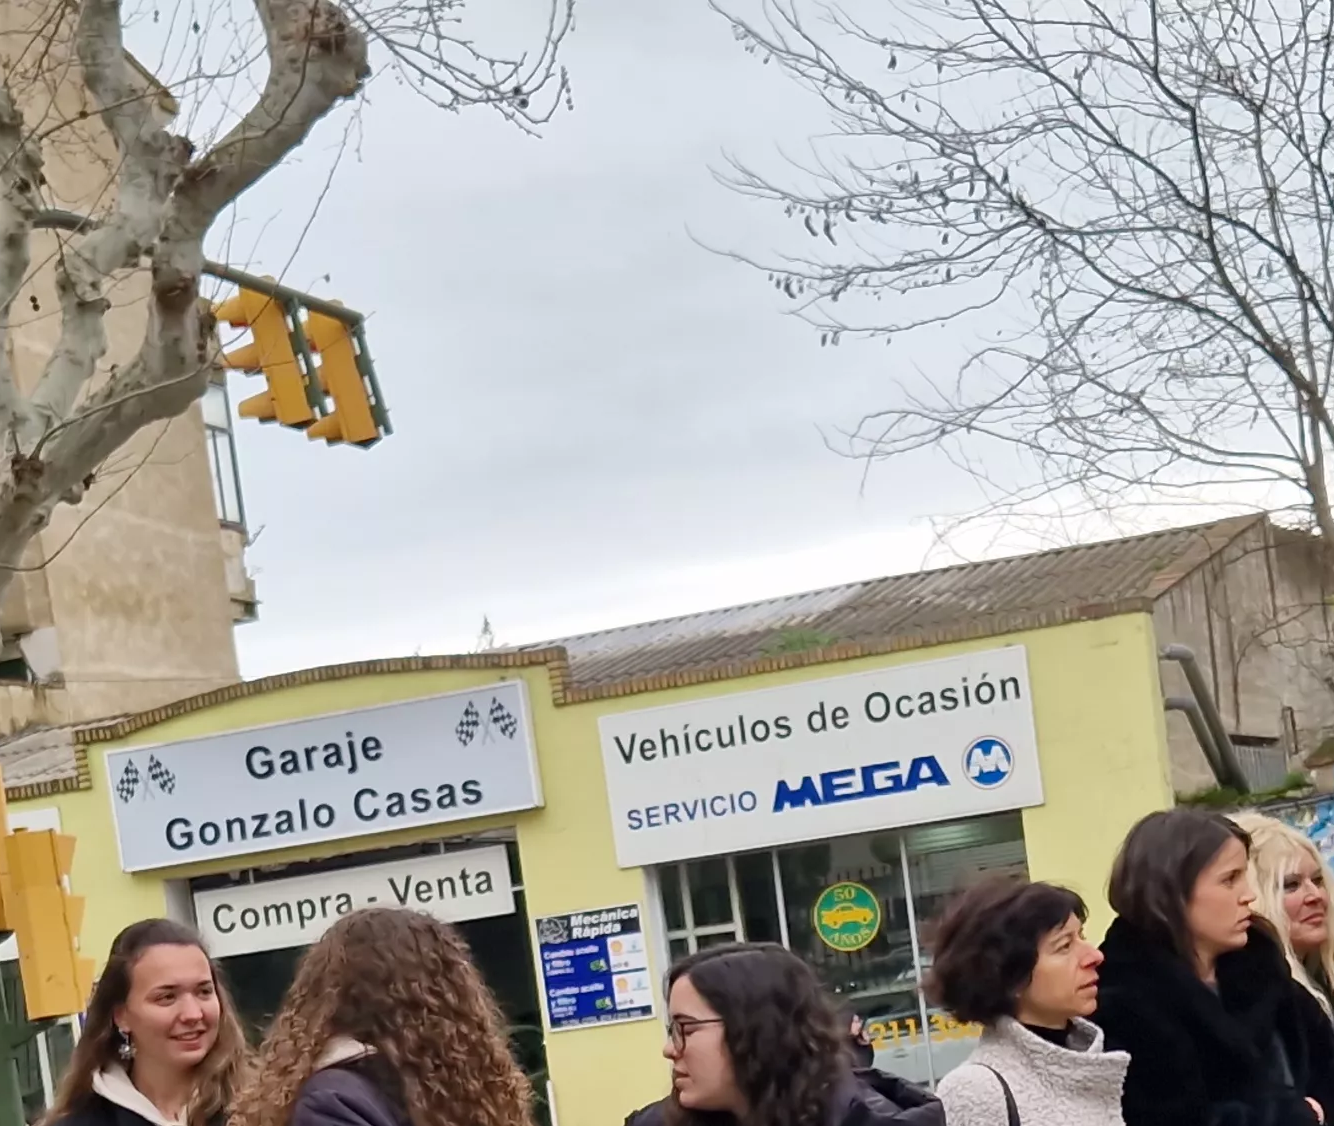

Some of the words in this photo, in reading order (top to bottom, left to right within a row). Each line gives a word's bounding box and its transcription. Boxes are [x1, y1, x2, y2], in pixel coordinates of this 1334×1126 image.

[614, 714, 792, 764] Vehículos
[807, 702, 850, 733] de
[864, 672, 1022, 723] Ocasión
[245, 731, 384, 780] Garaje
[165, 799, 336, 851] Gonzalo
[353, 778, 484, 822] Casas
[627, 790, 758, 831] SERVICIO
[772, 754, 951, 813] MEGA
[212, 889, 354, 934] Compra
[387, 866, 494, 908] Venta
[570, 908, 638, 927] Mecánica
[572, 922, 622, 939] Rápida
